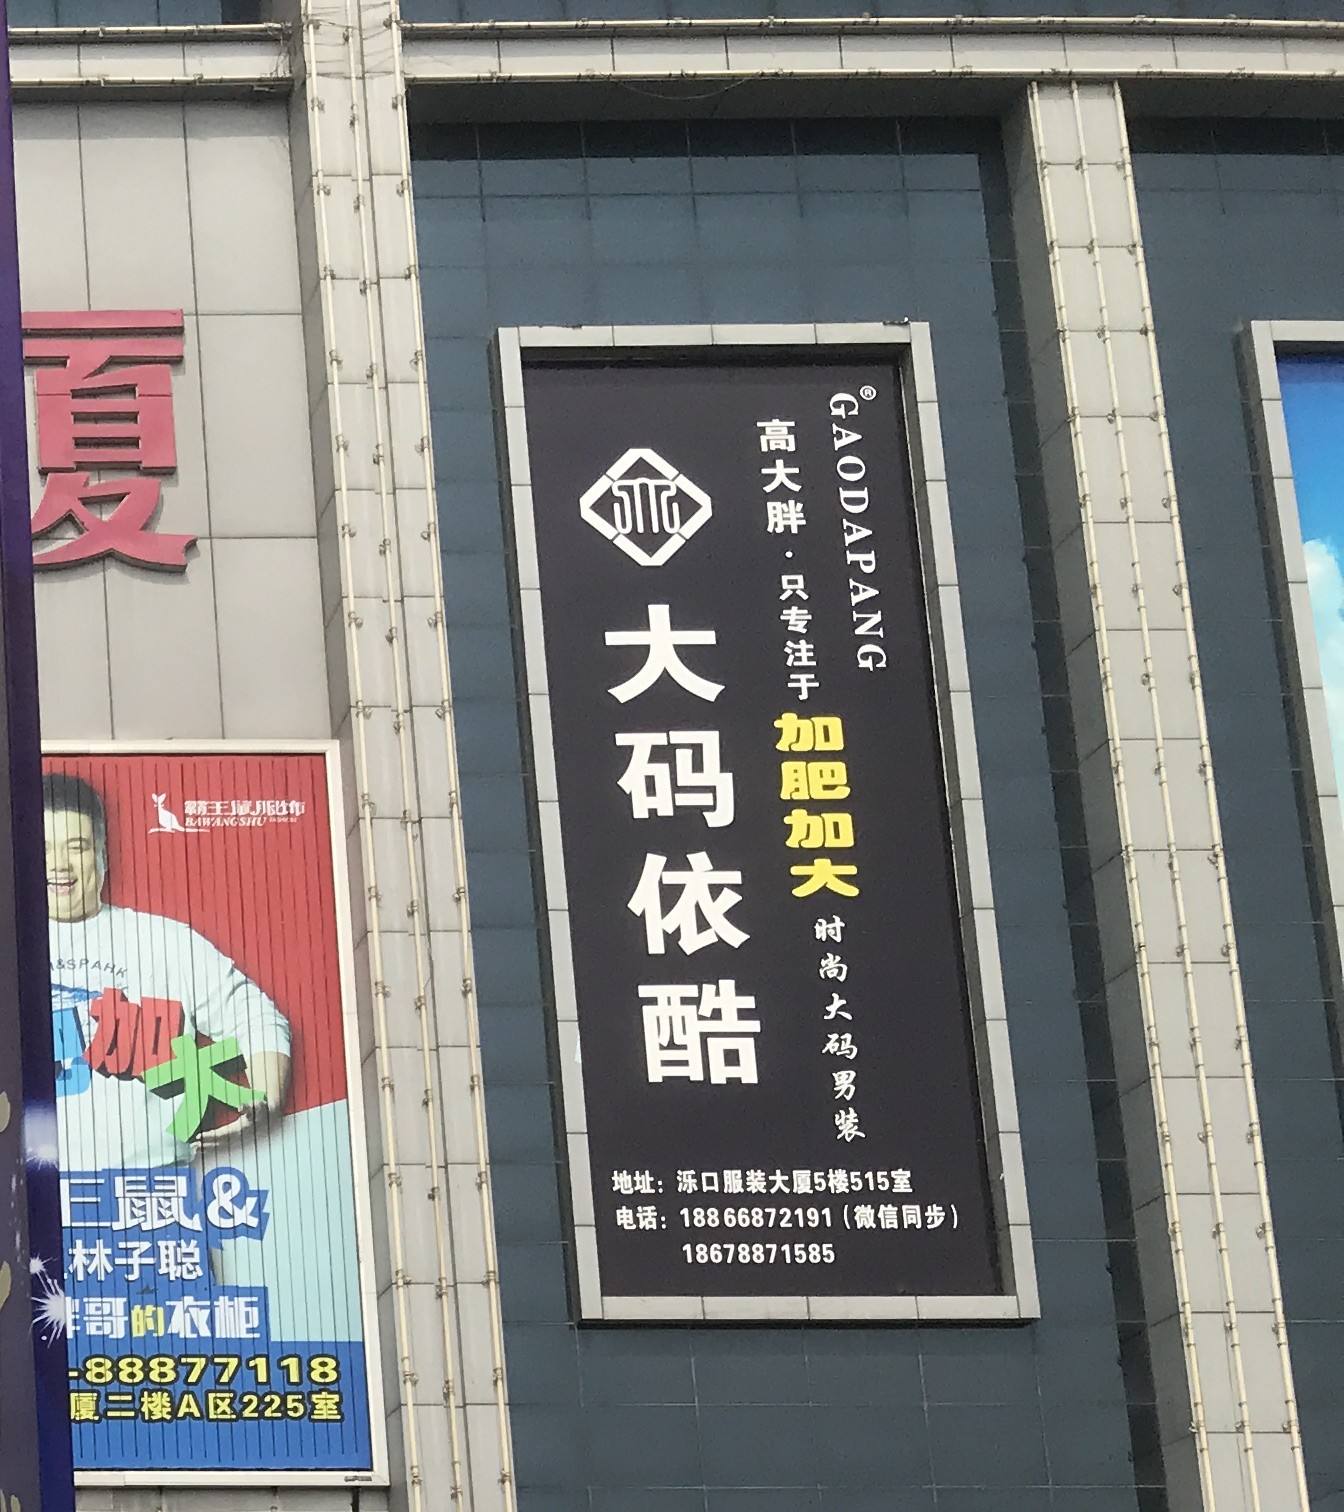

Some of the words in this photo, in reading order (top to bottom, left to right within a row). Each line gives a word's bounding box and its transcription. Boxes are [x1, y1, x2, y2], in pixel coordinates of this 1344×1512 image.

[828, 391, 888, 672] GAODAPANG
[602, 603, 762, 1086] 大码依酷
[773, 712, 862, 900] 加肥加大
[680, 1207, 832, 1229] 18866872191
[682, 1244, 835, 1265] 18678871585
